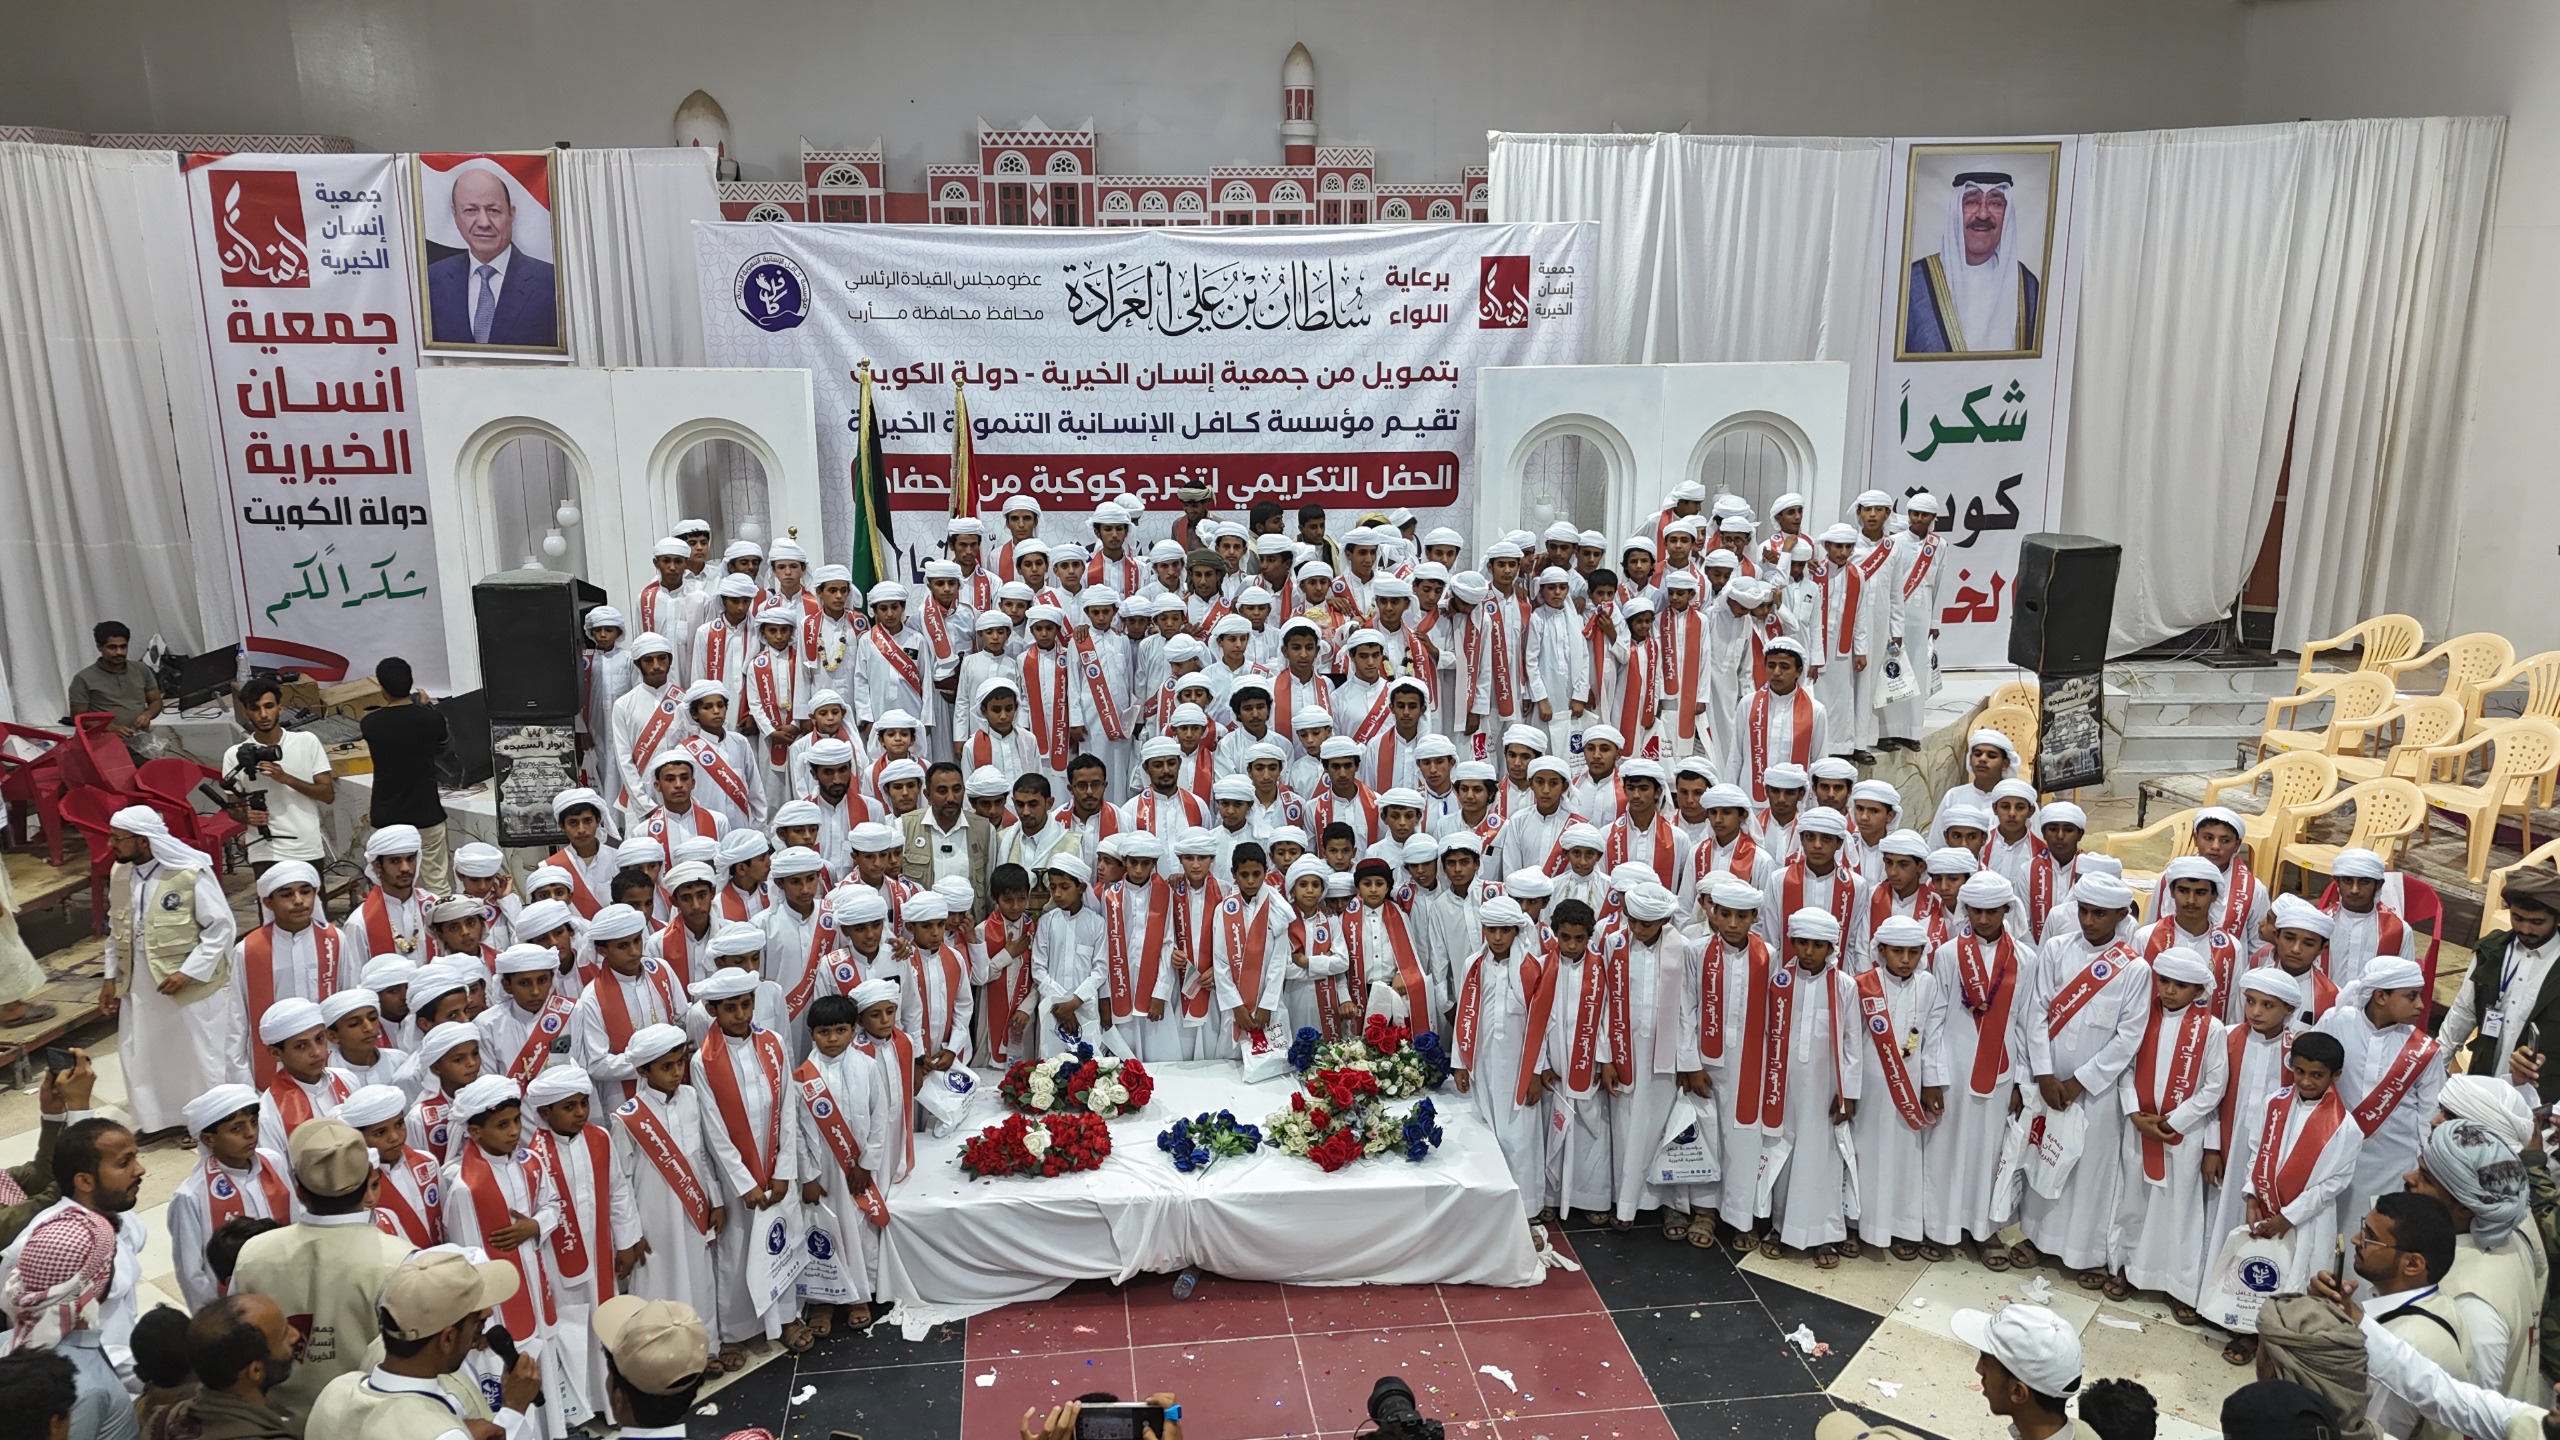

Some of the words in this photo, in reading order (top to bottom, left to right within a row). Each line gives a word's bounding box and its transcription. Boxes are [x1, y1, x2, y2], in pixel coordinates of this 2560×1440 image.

[315, 182, 381, 209] جمعية
[322, 216, 386, 244] إنسان
[321, 248, 389, 275] الخيرية
[1385, 264, 1450, 290] برعاية
[1537, 262, 1575, 276] جمعية
[845, 270, 901, 290] الرئاسي
[902, 271, 952, 288] القيادة
[954, 273, 1008, 288] مجلس
[1009, 272, 1042, 288] عضو
[1537, 281, 1574, 299] إنسان
[848, 301, 909, 322] مأرب
[912, 304, 981, 321] محافظة
[986, 305, 1044, 321] محافظ
[1389, 304, 1449, 329] اللواء
[1535, 302, 1573, 319] الخيرية
[228, 300, 398, 355] جمعية
[951, 360, 1018, 391] دولة
[1042, 361, 1129, 390] الخيرية
[1135, 362, 1215, 392] إنسان
[1221, 361, 1308, 389] جمعية
[1316, 366, 1355, 389] من
[1362, 362, 1459, 389] بتمويل
[236, 366, 404, 418] انسان
[847, 409, 936, 440] الخيرة
[943, 409, 1050, 440] التنموة
[1057, 409, 1174, 441] الإنسانية
[1181, 410, 1260, 439] كافل
[1267, 408, 1374, 438] مؤسسة
[1382, 409, 1459, 438] تقيم
[1900, 378, 2028, 462] شكراً
[245, 429, 412, 485] الخيرية
[979, 474, 1022, 502] من
[1030, 465, 1125, 501] كوكبة
[1227, 466, 1358, 509] التكريمي
[1365, 464, 1452, 500] الحفل
[244, 496, 350, 531] الكويت
[361, 496, 427, 530] دولة
[266, 551, 329, 627] لكم
[322, 937, 335, 978] جمعية
[1964, 944, 1981, 985] جمعية
[1585, 964, 1602, 1001] جمعية
[1612, 959, 1624, 996] جمعية
[1707, 969, 1720, 1001] إنسان
[1613, 996, 1626, 1029] إنسان
[2058, 982, 2091, 1012] جمعية
[1582, 1001, 1598, 1034] إنسان
[1705, 1001, 1718, 1037] الخيرية
[1771, 996, 1788, 1036] جمعية
[1575, 1034, 1591, 1070] الخيرية
[1614, 1029, 1628, 1065] الخيرية
[1770, 1036, 1784, 1069] إنسان
[1882, 1042, 1901, 1083] جمعية
[2176, 1051, 2197, 1088] إنسان
[2390, 1055, 2422, 1091] إنسان
[1766, 1068, 1780, 1106] الخيرية
[2360, 1087, 2396, 1121] الخيرية
[640, 1119, 670, 1162] جمعية
[2262, 1108, 2282, 1151] جمعية
[2259, 1150, 2273, 1188] إنسان
